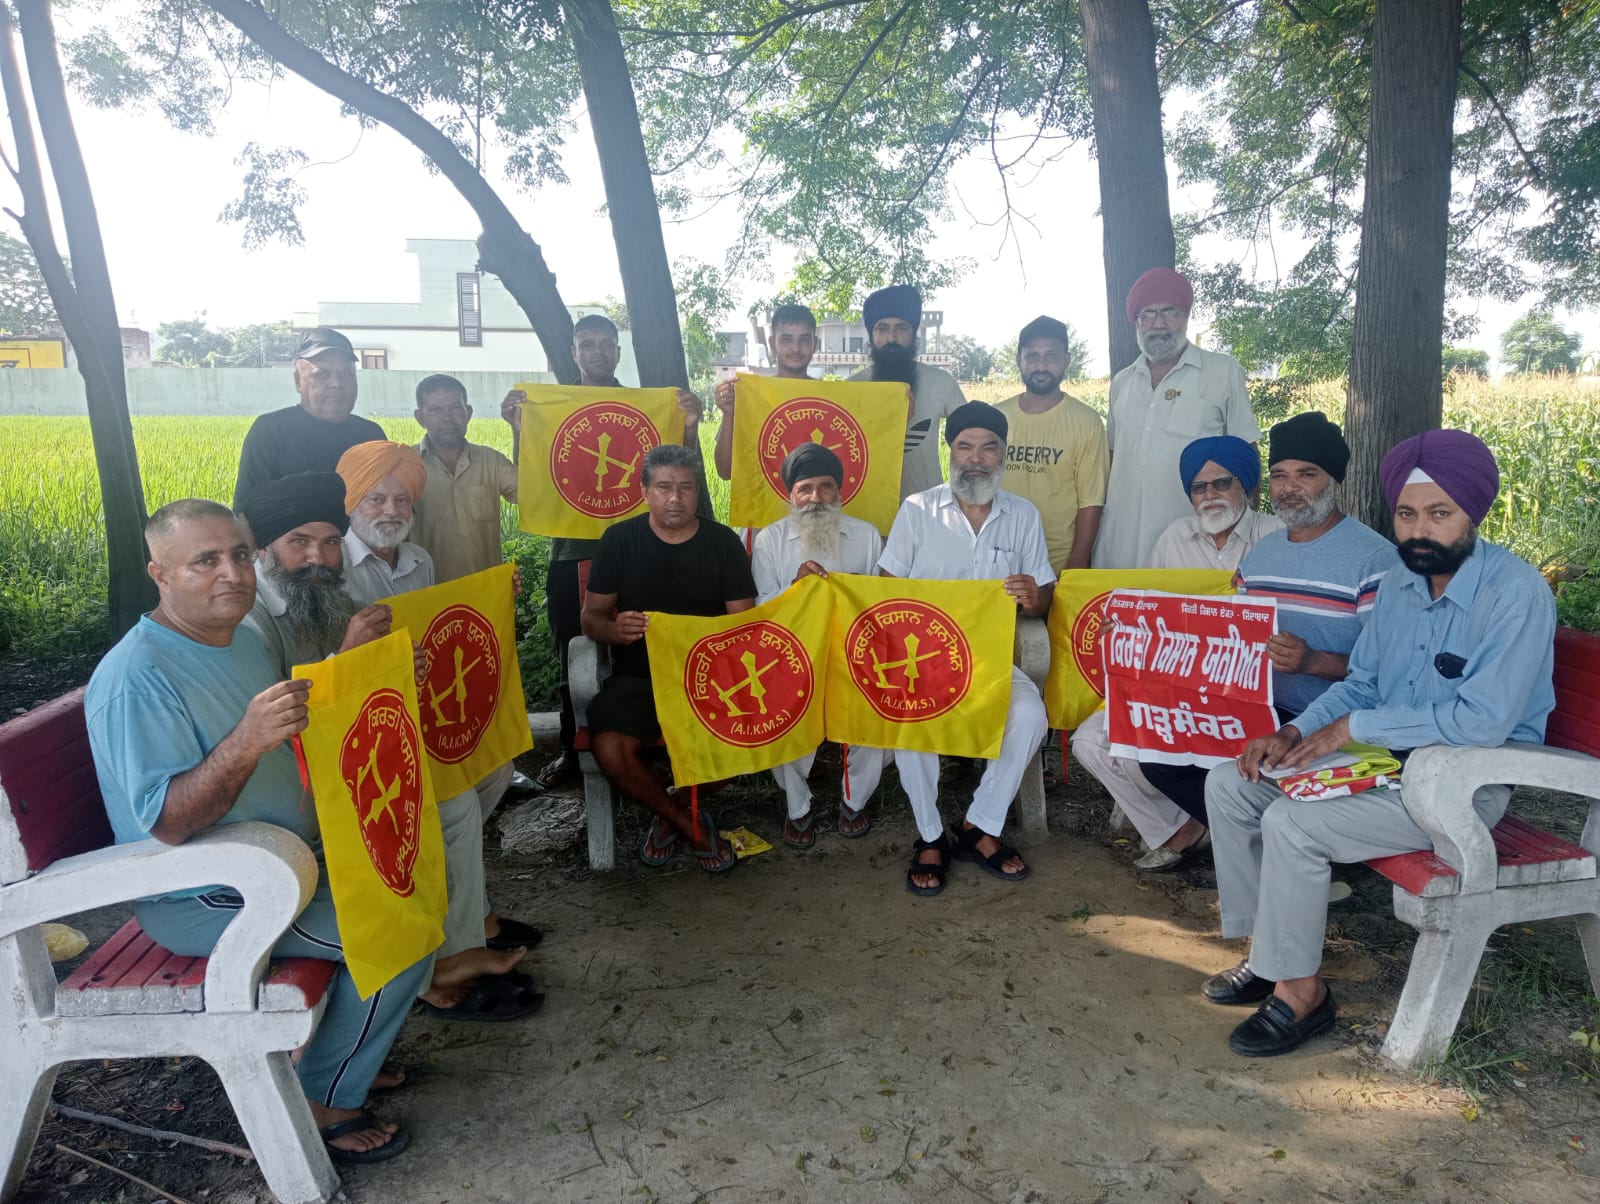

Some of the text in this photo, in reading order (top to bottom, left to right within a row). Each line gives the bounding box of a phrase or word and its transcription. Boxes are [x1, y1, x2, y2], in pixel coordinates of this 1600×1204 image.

[764, 408, 861, 463] ਕਿਰਤੀ ਕਿਸਾਨ ਯੂਨੀਅਨ
[1006, 445, 1064, 465] RBERRY
[432, 620, 464, 651] ਕਿਸਾਨ
[851, 610, 963, 673] ਕਿਰਤੀ ਕਿਸਾਨ ਯੂਨੀਅਨ
[1079, 612, 1102, 655] ਕਿਰਤੀ
[1110, 612, 1153, 670] ਕਿਰਤੀ
[1149, 616, 1201, 678] ਕਿਸਾਨ
[693, 629, 805, 700] ਕਿਰਤੀ ਕਿਸਾਨ ਯੂਨੀਅਨ
[367, 704, 402, 735] ਕਿਰਤੀ
[880, 693, 936, 711] (A.I.K.M.S.)
[730, 709, 791, 736] (A.I.K.M.S.)
